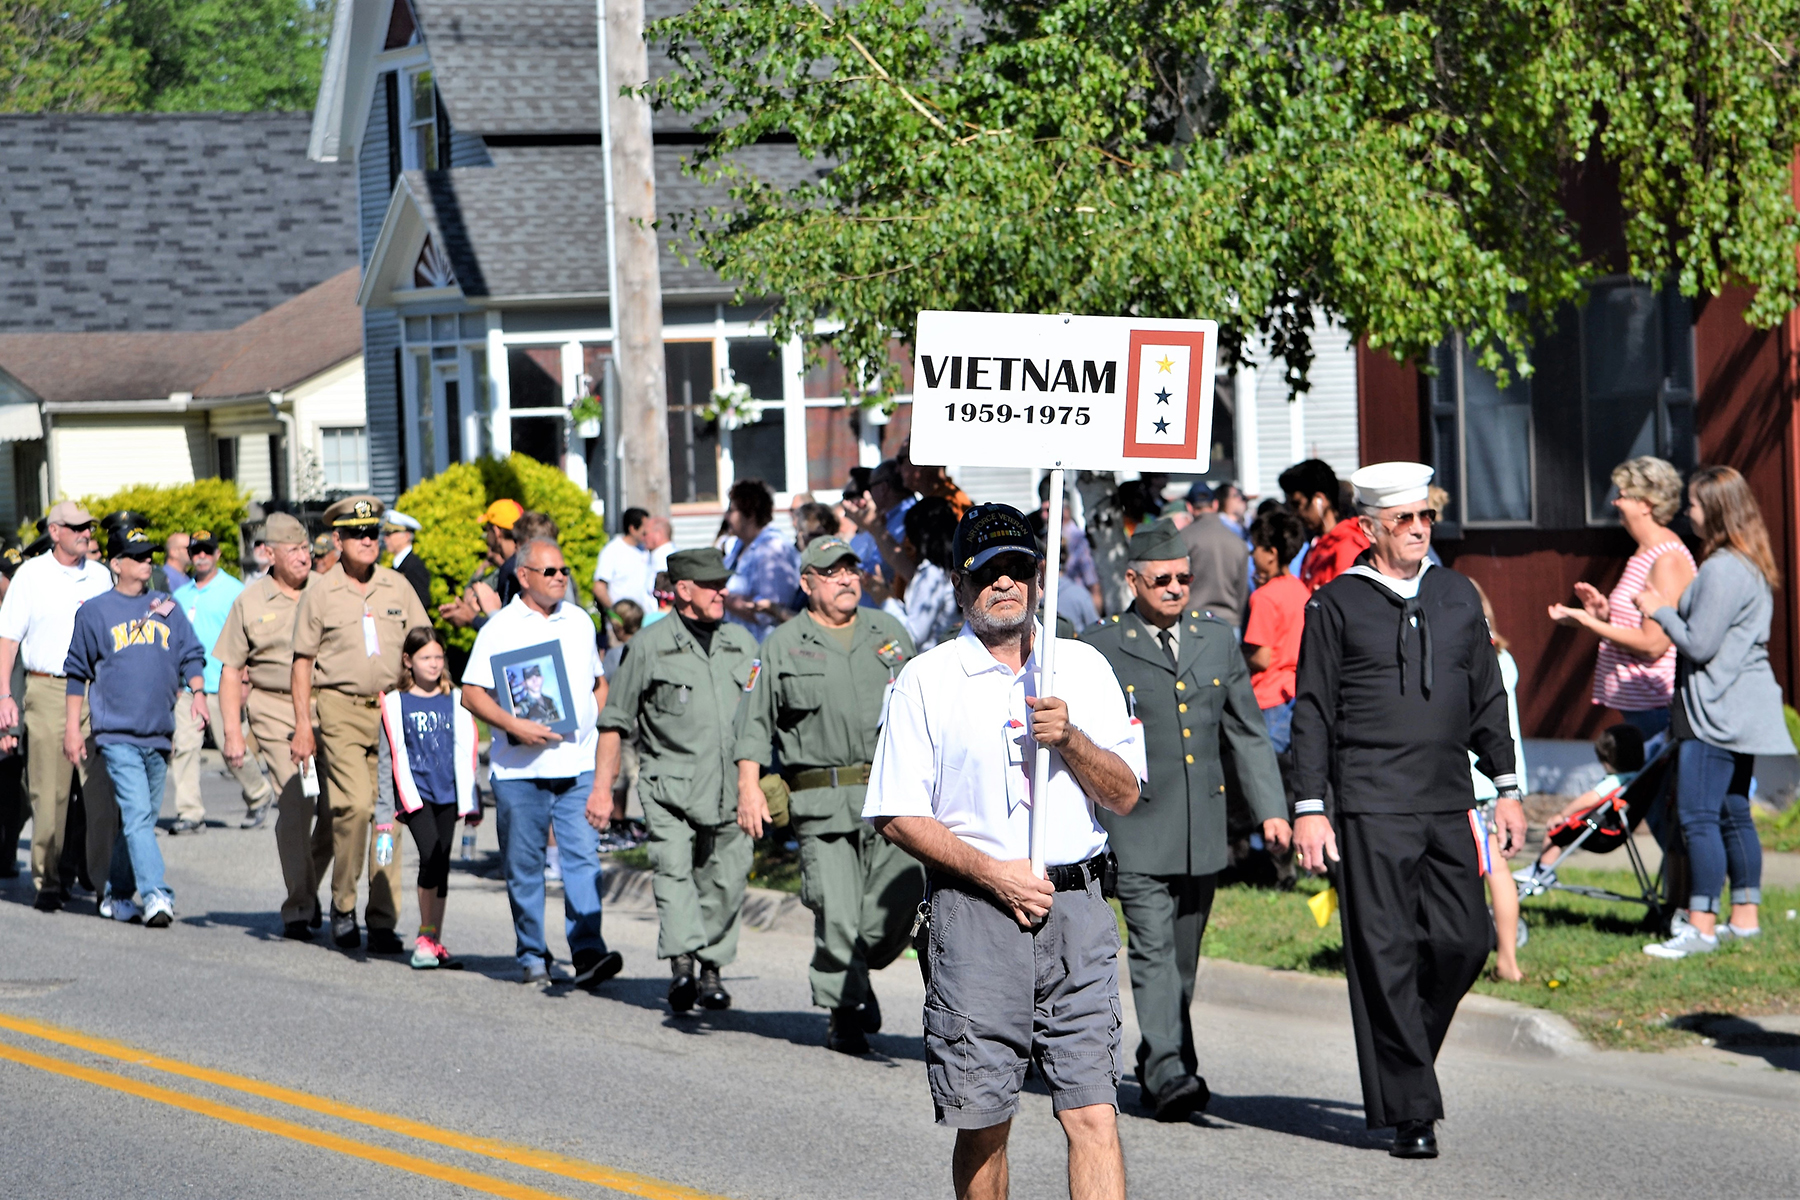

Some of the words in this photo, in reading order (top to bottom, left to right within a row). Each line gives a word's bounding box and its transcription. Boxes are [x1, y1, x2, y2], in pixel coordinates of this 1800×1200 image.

[921, 355, 1117, 394] VIETNAM
[945, 403, 1091, 426] 1959-1975
[966, 529, 977, 542] AIR
[974, 513, 997, 530] FORCE
[998, 513, 1028, 535] VETERAN
[111, 619, 171, 653] NAVY
